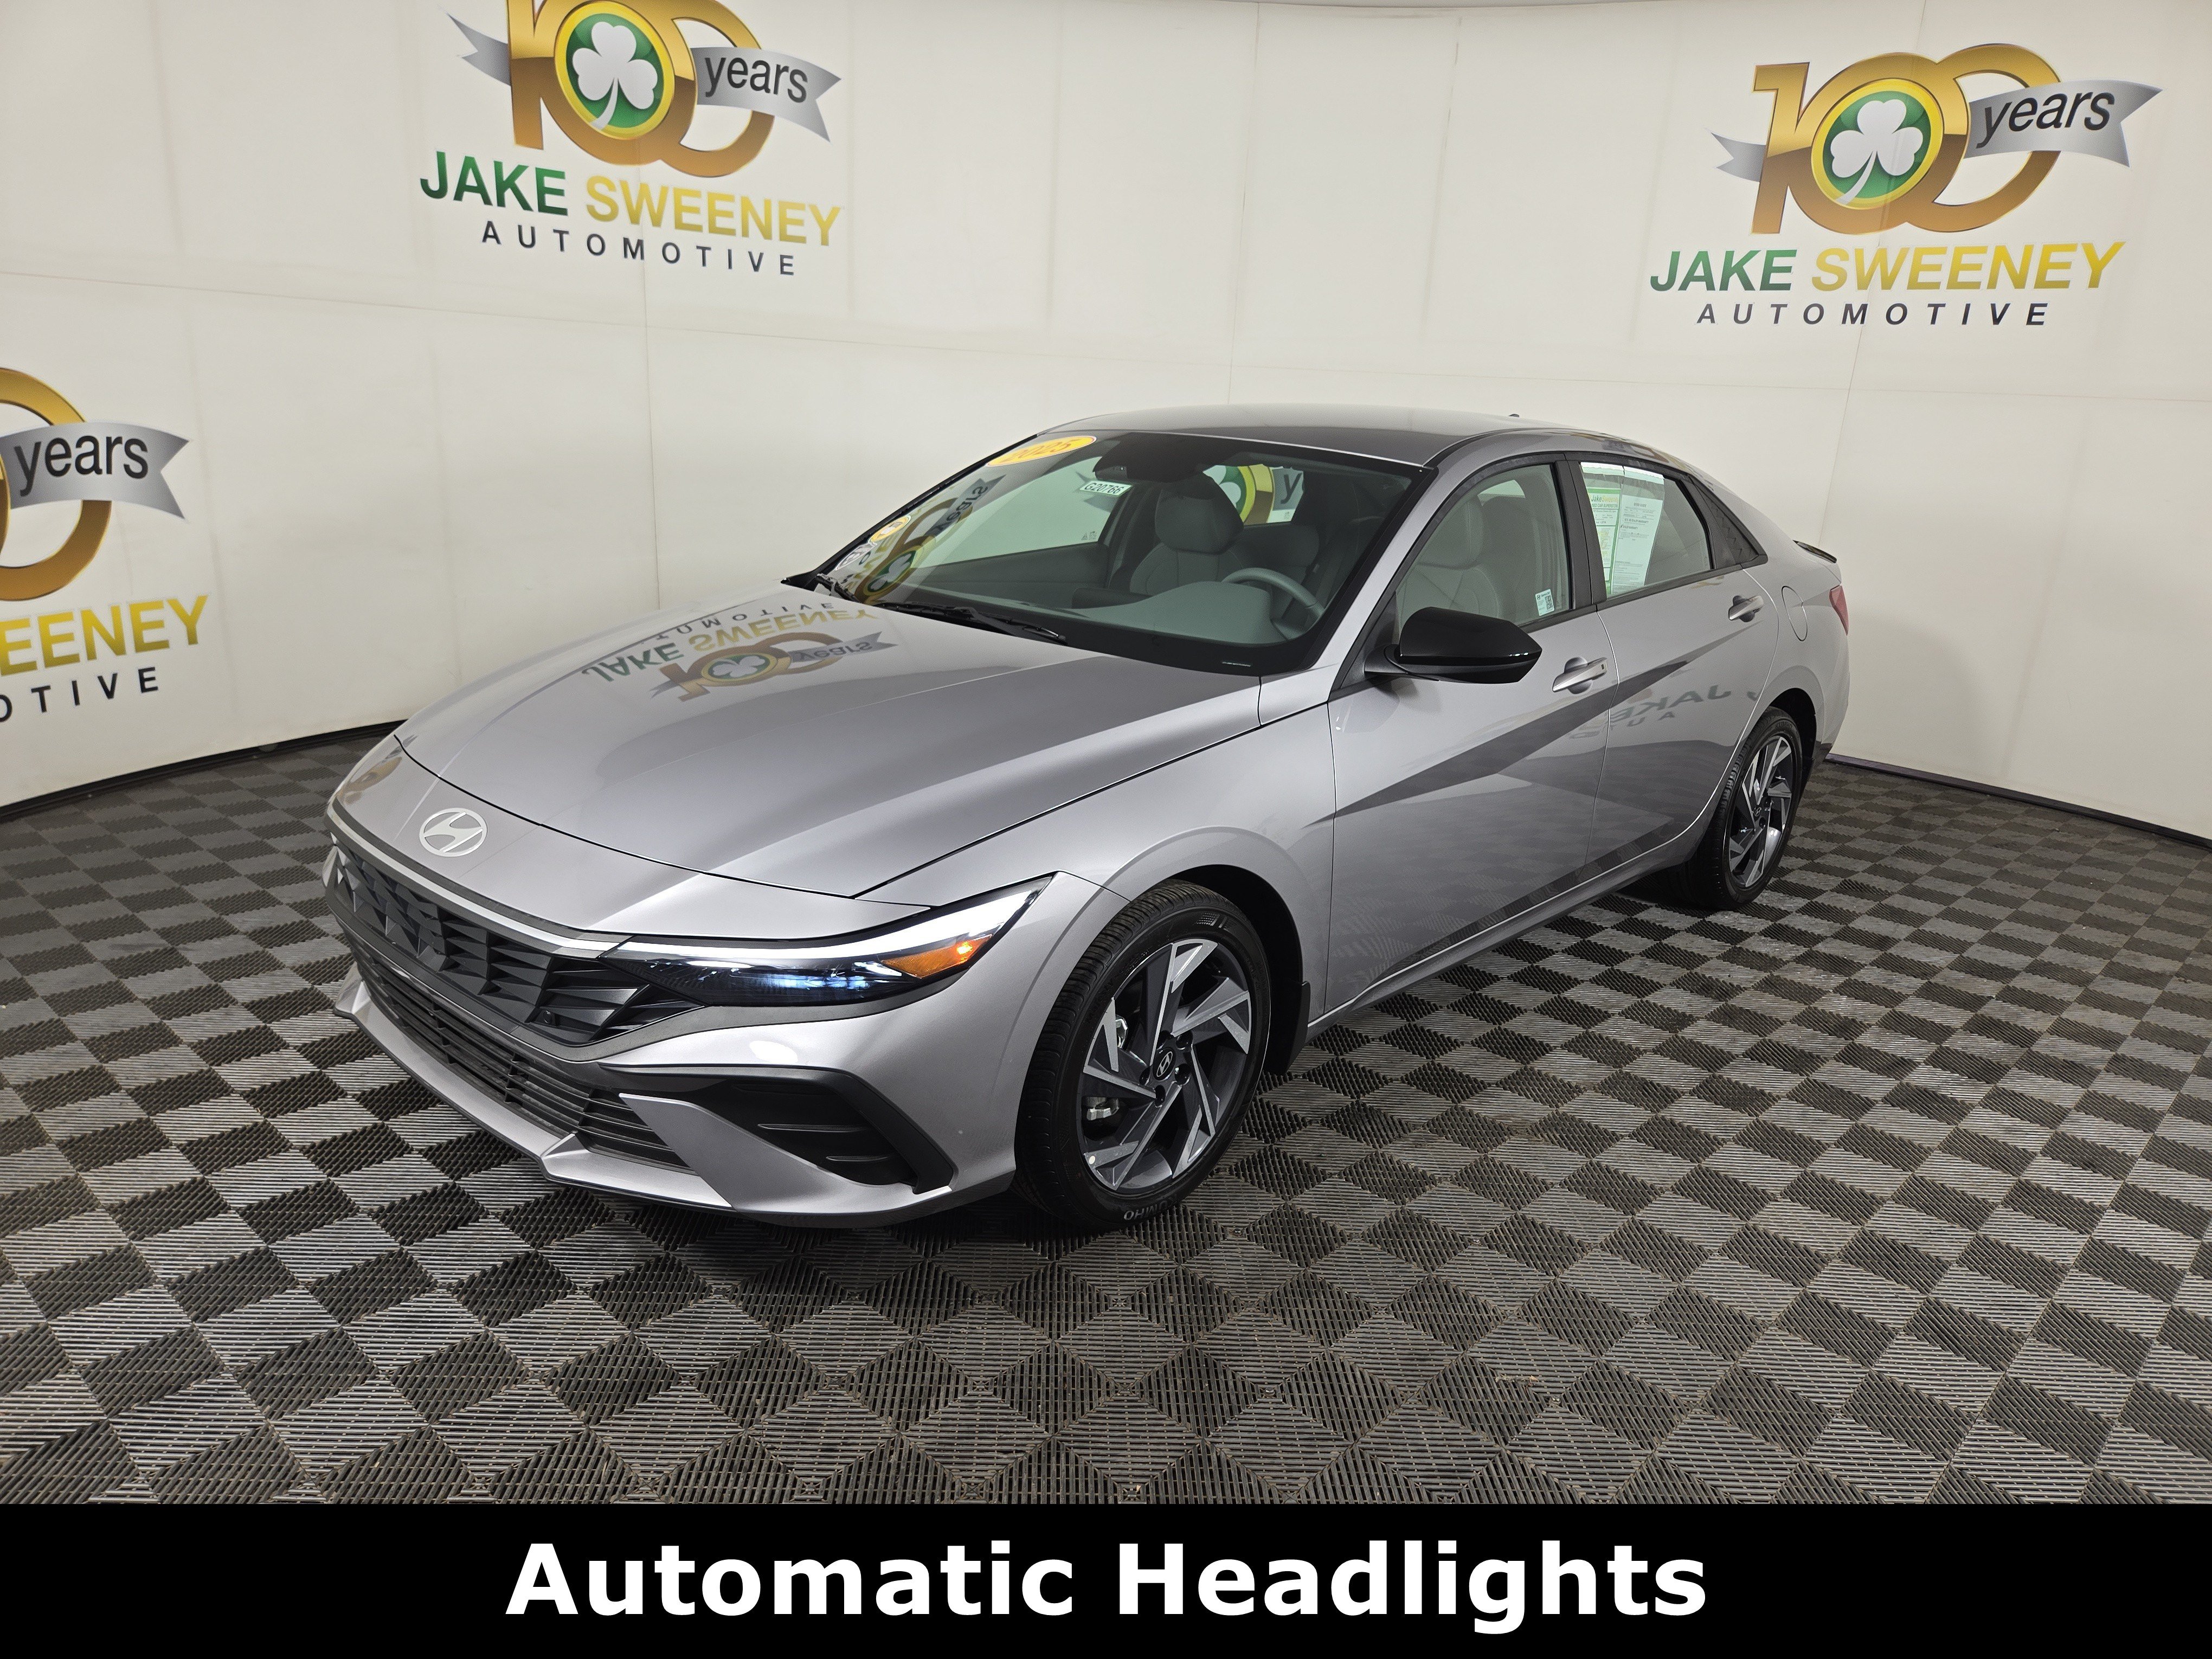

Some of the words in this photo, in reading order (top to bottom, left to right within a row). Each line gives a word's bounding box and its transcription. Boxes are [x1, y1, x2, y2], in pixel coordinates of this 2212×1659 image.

[705, 55, 808, 103] years
[1975, 90, 2115, 149] years
[419, 151, 568, 216] JAKE
[586, 176, 841, 246] SWEENEY
[481, 220, 795, 275] AUTOMOTIVE
[1650, 248, 1797, 292] JAKE
[1811, 241, 2126, 292] SWEENEY
[1696, 302, 2049, 326] AUTOMOTIVE
[14, 435, 148, 497] years
[1000, 439, 1083, 462] 2025
[1084, 483, 1124, 494] G20766
[0, 595, 208, 676] EENEY
